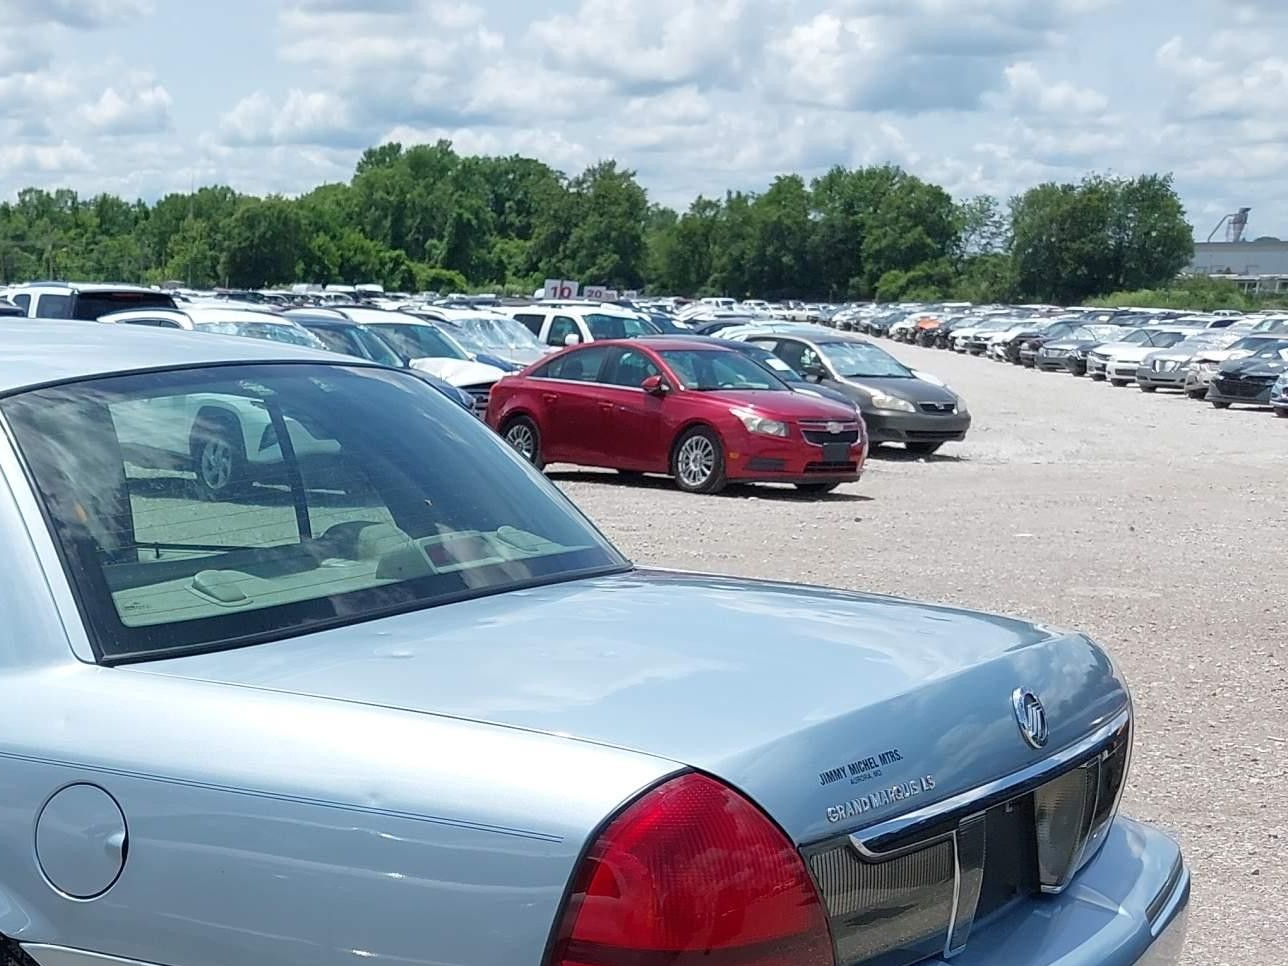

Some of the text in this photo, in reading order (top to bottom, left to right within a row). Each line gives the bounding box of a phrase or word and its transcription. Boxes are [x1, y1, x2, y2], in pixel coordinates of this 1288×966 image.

[550, 286, 572, 299] 10
[819, 749, 904, 786] JIMMY MICHEL MTRS.
[826, 775, 936, 823] GRAND MARQUIS LS
